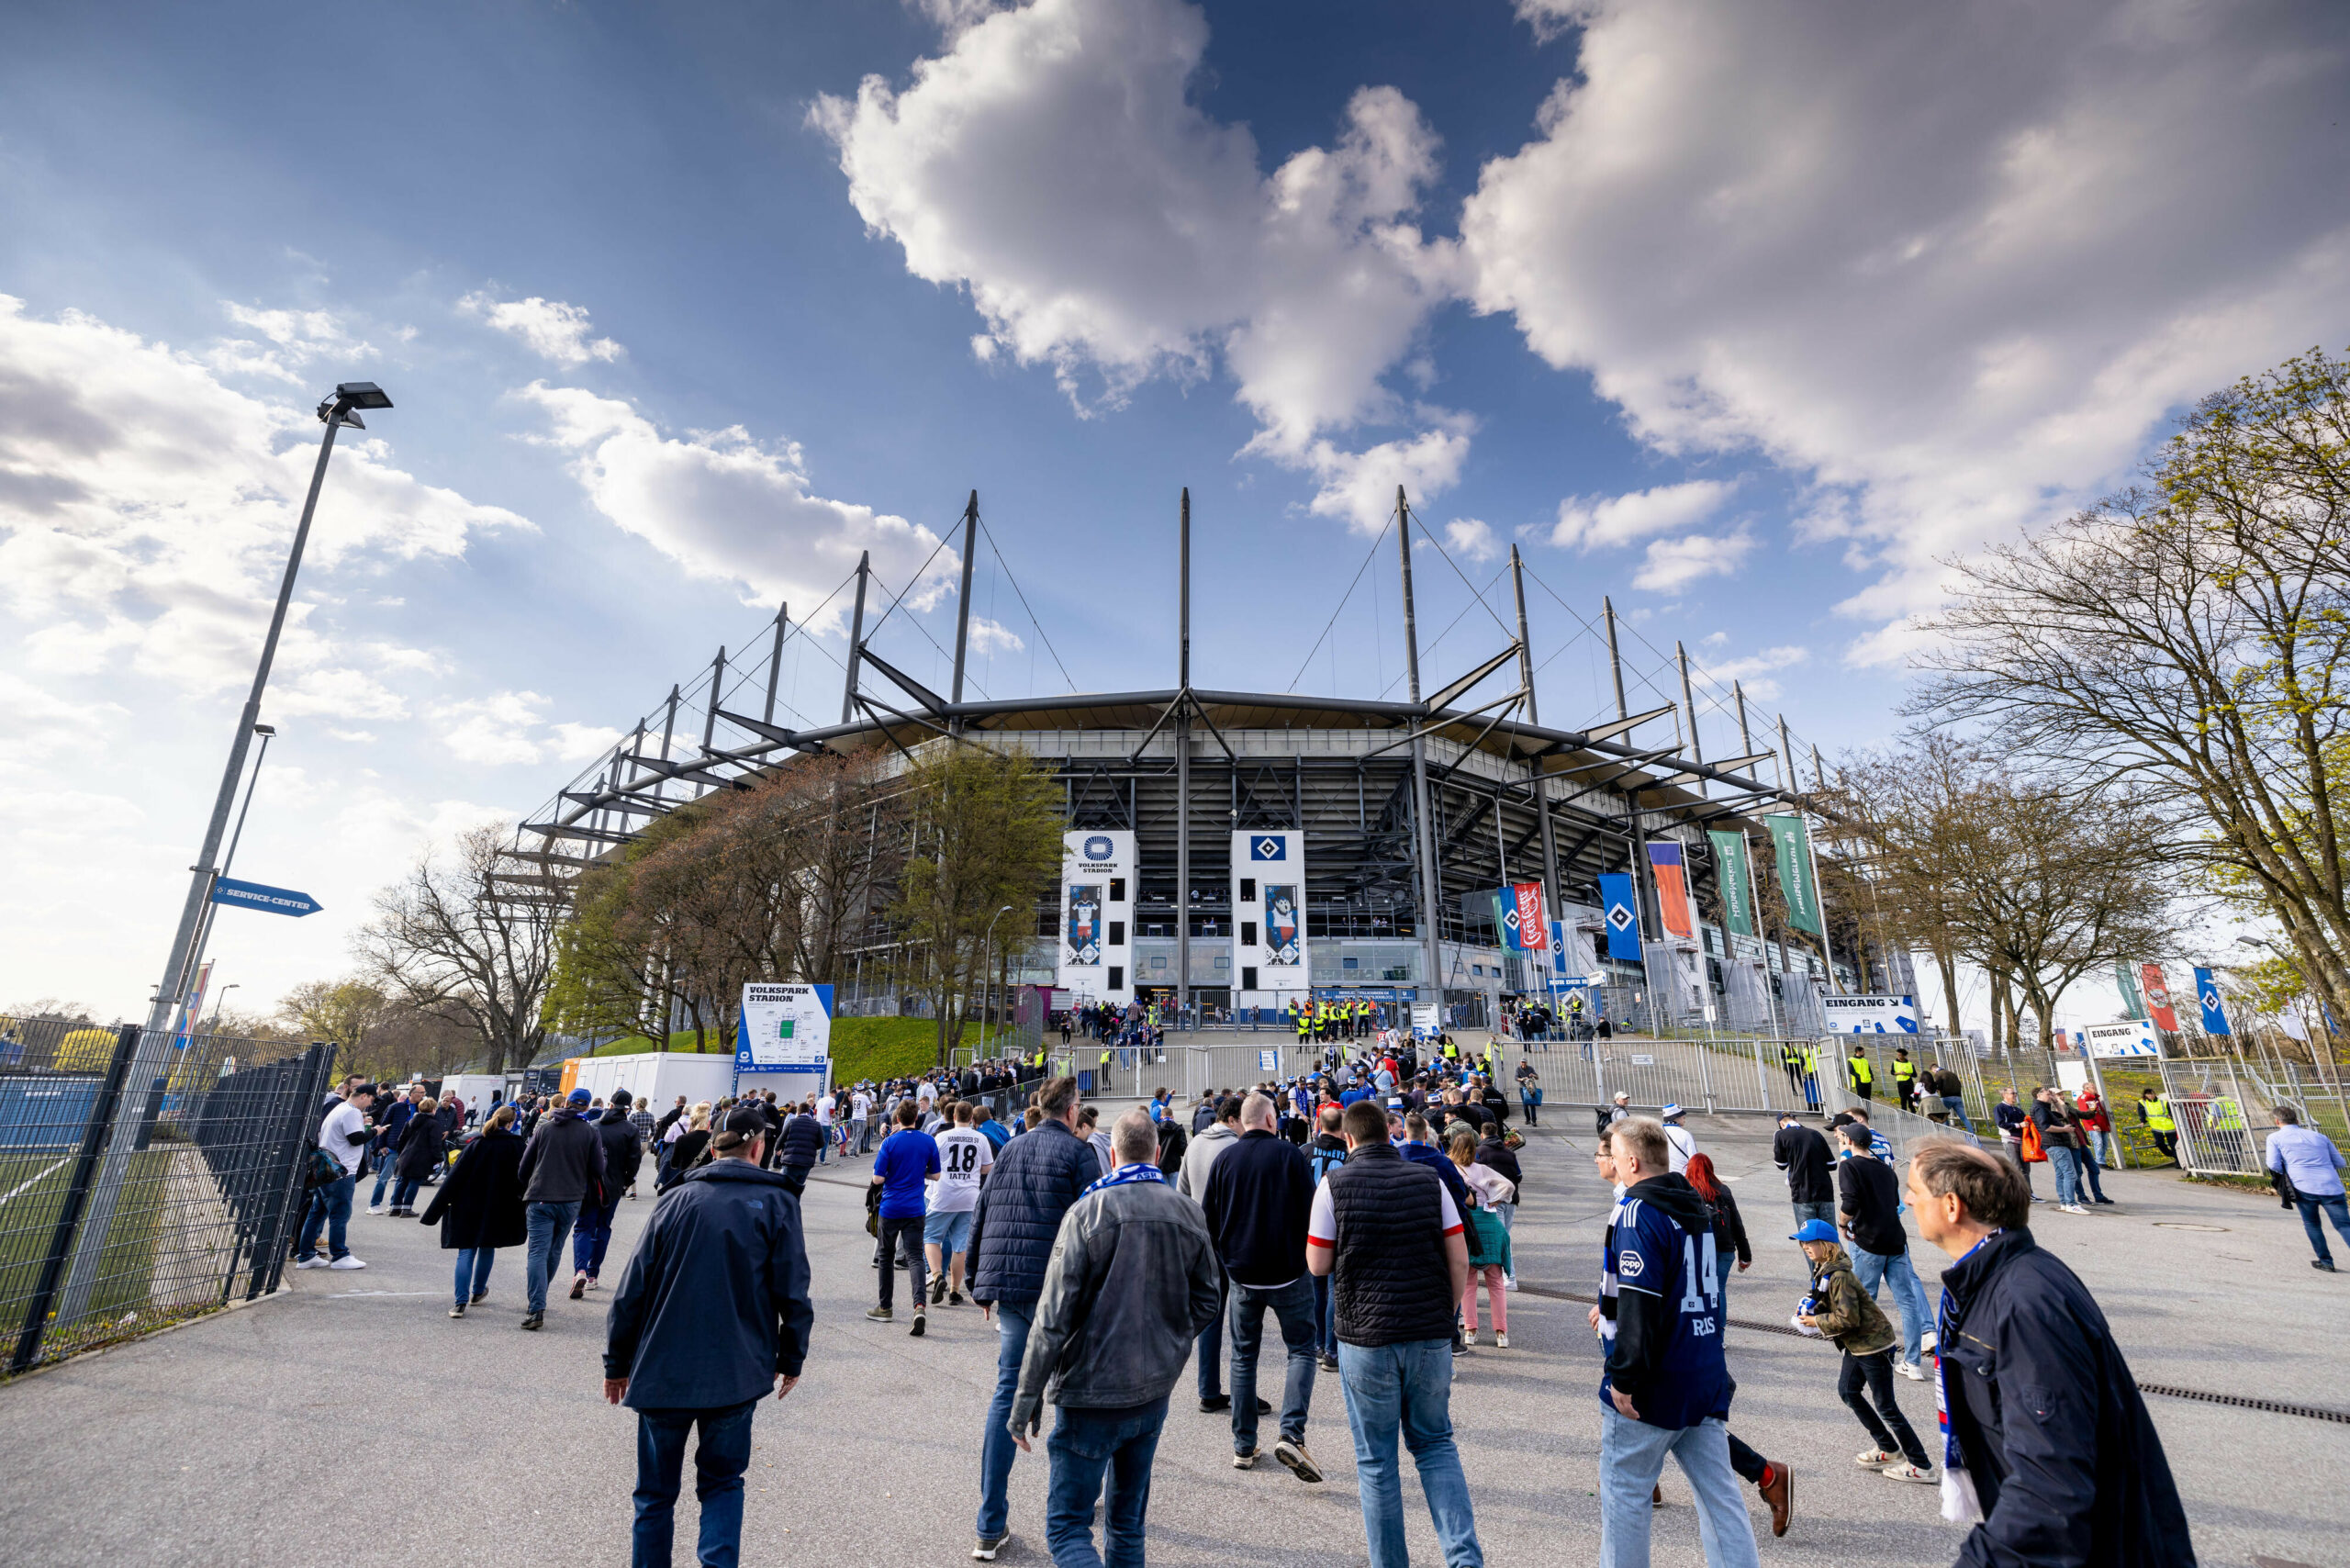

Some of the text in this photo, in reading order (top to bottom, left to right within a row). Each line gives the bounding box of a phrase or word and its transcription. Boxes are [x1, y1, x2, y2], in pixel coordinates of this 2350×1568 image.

[227, 889, 310, 910] SERVICE-CENTER
[749, 986, 809, 994] VOLKSPARK
[1825, 999, 1886, 1007] EINGANG
[2091, 1028, 2131, 1037] EINGANG
[947, 1144, 977, 1172] 18
[1620, 1260, 1641, 1270] popp
[1680, 1232, 1719, 1313] 14
